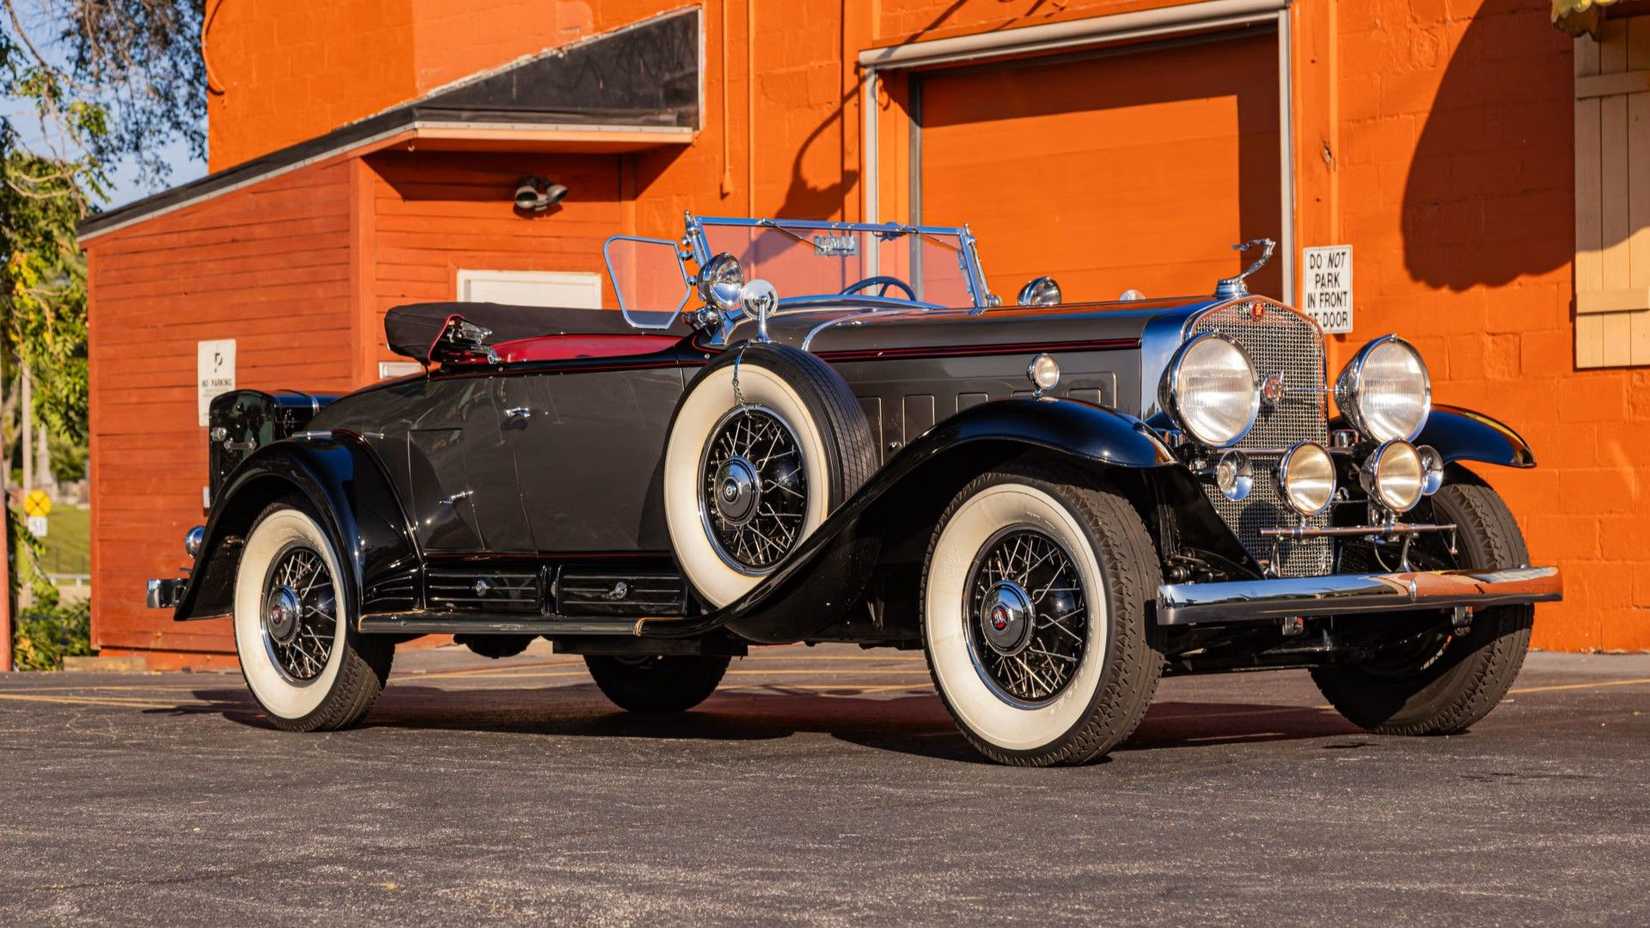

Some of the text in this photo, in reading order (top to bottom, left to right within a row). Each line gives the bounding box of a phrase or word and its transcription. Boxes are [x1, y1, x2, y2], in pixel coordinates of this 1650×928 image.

[1309, 252, 1347, 269] DO NOT
[1315, 272, 1341, 288] PARK
[1307, 291, 1348, 308] IN FRONT
[1323, 311, 1349, 328] DOOR
